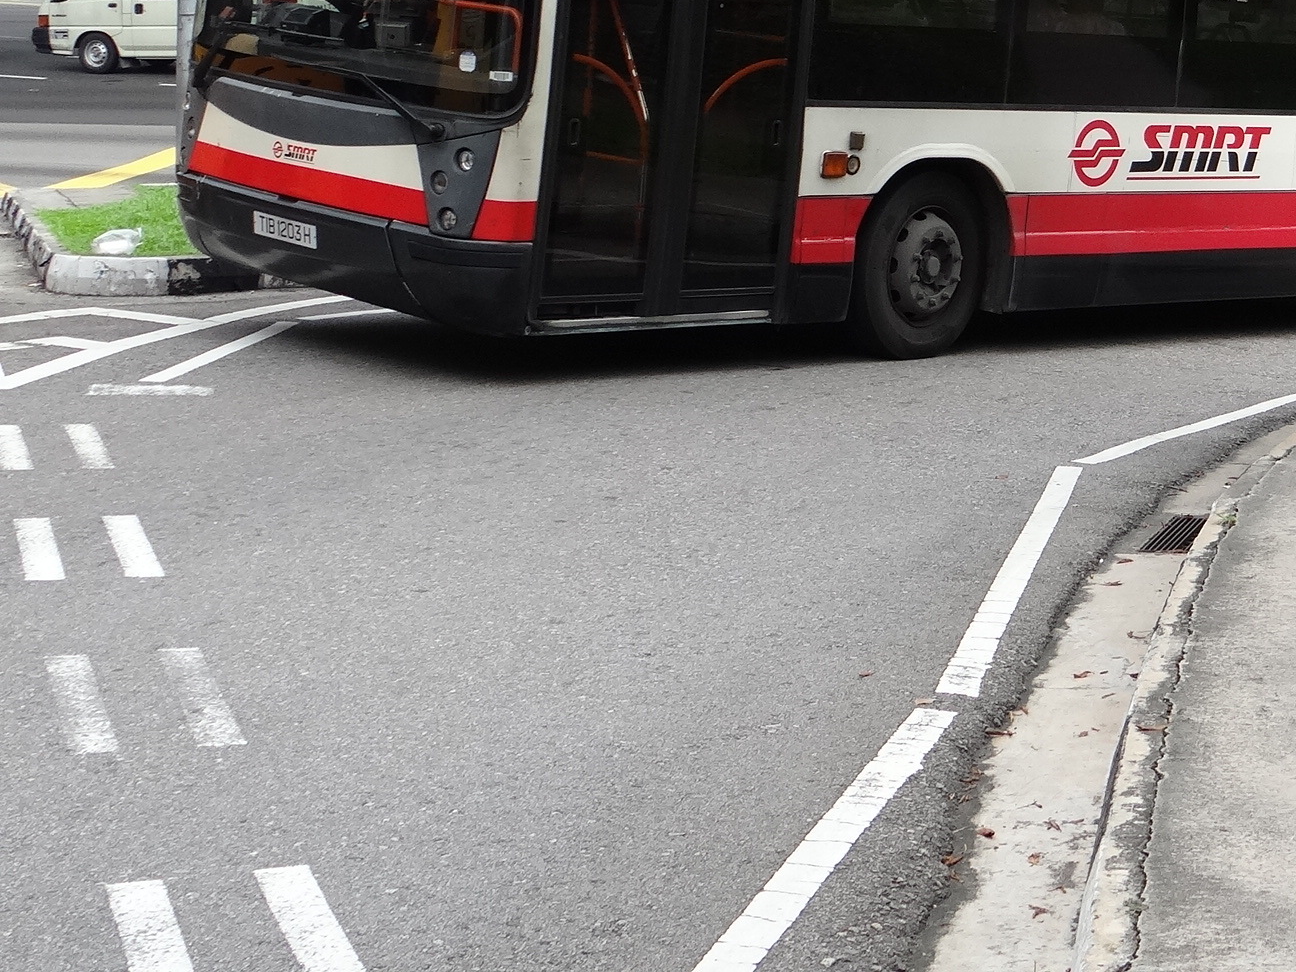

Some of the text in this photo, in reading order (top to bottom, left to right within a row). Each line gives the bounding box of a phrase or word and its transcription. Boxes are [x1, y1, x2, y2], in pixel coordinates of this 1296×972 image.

[284, 144, 317, 162] SMRT
[1129, 125, 1272, 173] SMRT
[258, 215, 312, 244] TIB1203H
